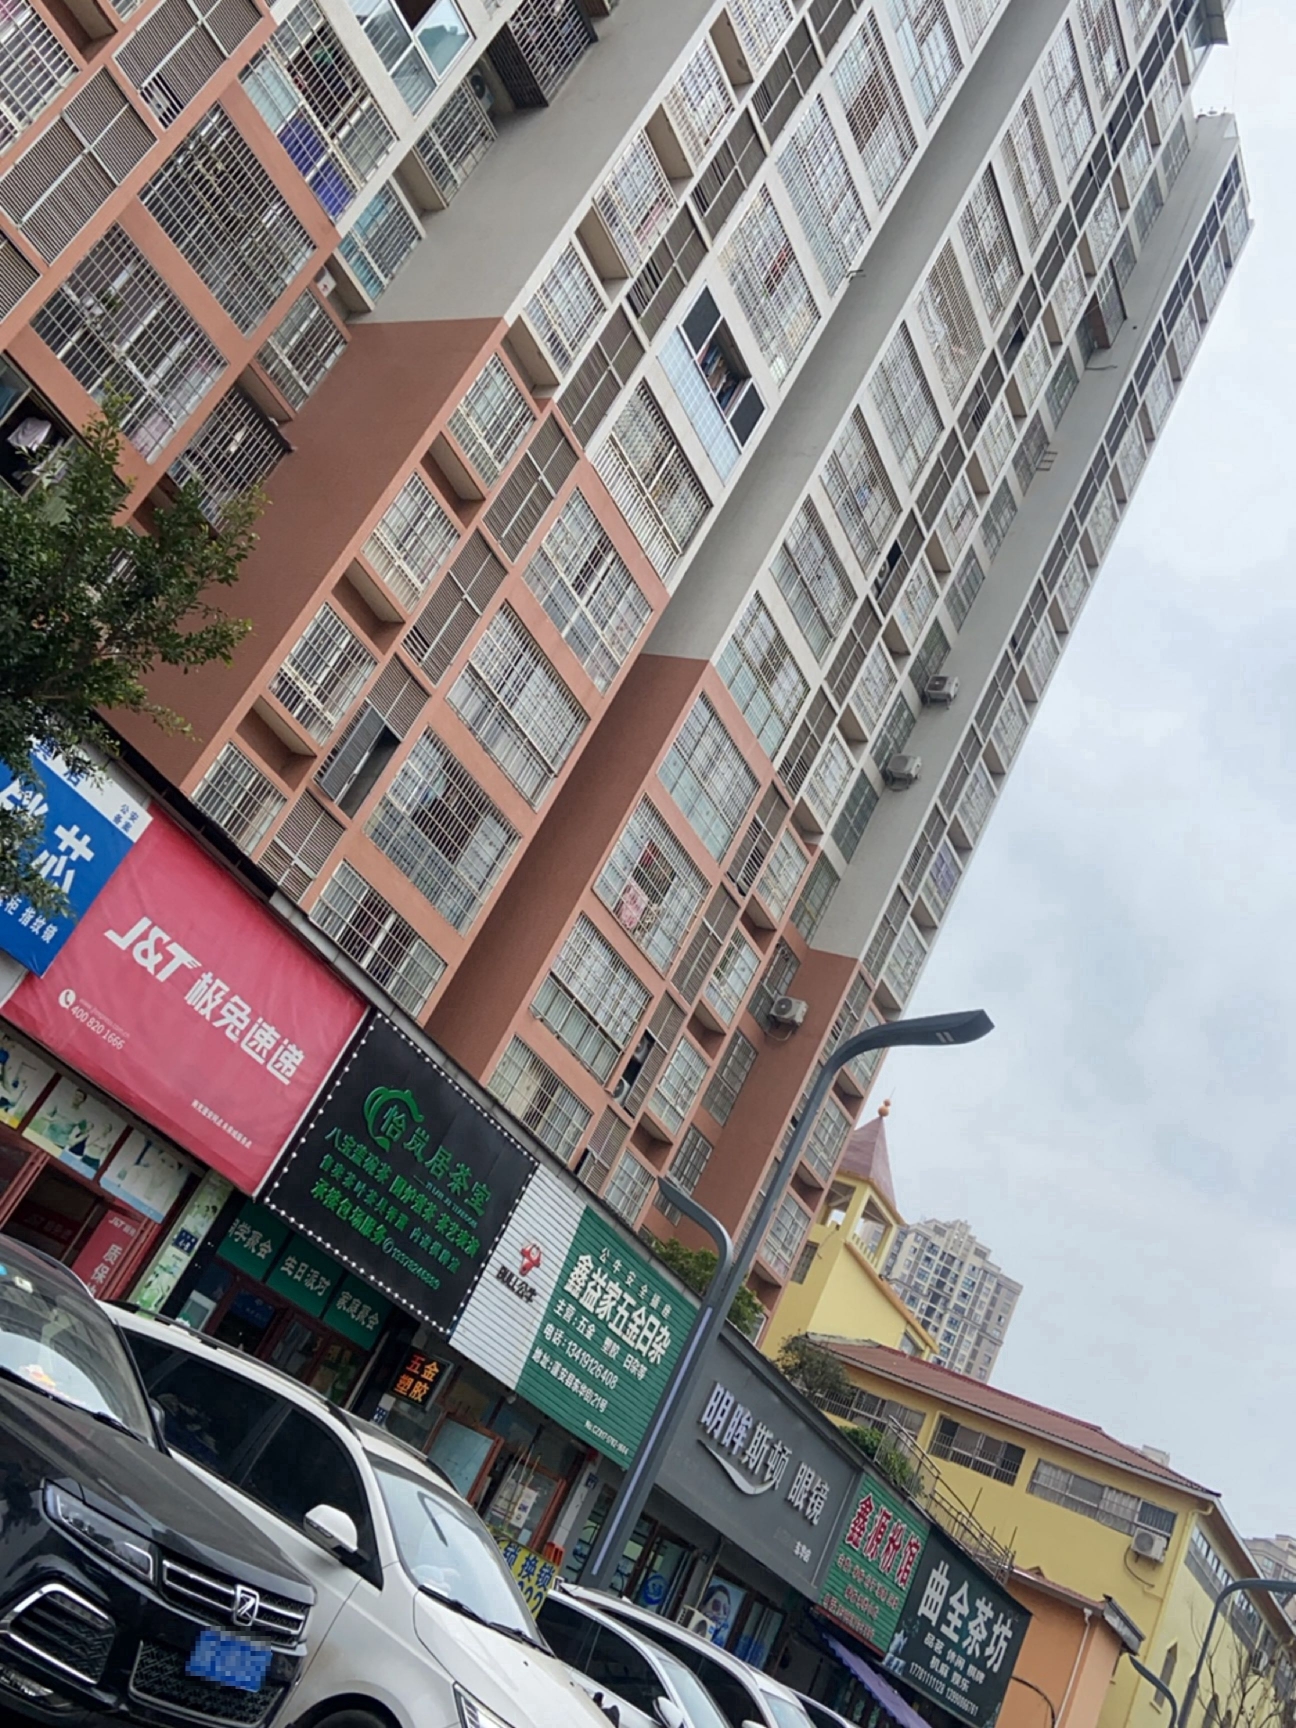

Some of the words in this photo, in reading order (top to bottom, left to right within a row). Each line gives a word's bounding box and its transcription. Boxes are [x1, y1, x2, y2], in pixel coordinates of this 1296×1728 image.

[18, 907, 59, 944] 指纹锁
[104, 917, 202, 982] J&T
[184, 972, 304, 1085] 极兔速递
[71, 1006, 89, 1022] 400
[86, 1017, 104, 1034] 820
[102, 1029, 125, 1049] 1666
[381, 1105, 492, 1216] 怡岚居茶室
[310, 1178, 387, 1245] 承接包场服务
[324, 1127, 392, 1184] 八宝盖碗茶
[389, 1175, 437, 1223] 围炉煮茶
[434, 1213, 480, 1257] 茶艺表演
[280, 1256, 330, 1296] 生日派对
[336, 1291, 379, 1330] 家庭聚会
[564, 1254, 671, 1364] 鑫益家五金日杂
[406, 1354, 439, 1382] 五金
[601, 1337, 620, 1359] 塑胶
[623, 1353, 647, 1380] 日杂等
[394, 1374, 430, 1403] 塑胶
[701, 1382, 792, 1490] 明眸斯顿
[787, 1461, 830, 1526] 眼镜
[847, 1496, 920, 1585] 鑫源粉馆
[517, 1553, 556, 1592] 换锁
[917, 1560, 1012, 1673] 曲全茶坊
[924, 1632, 944, 1654] 品茗
[946, 1649, 965, 1670] 休闲
[967, 1664, 985, 1683] 棋牌
[930, 1655, 949, 1677] 机麻
[951, 1671, 969, 1691] 娱乐
